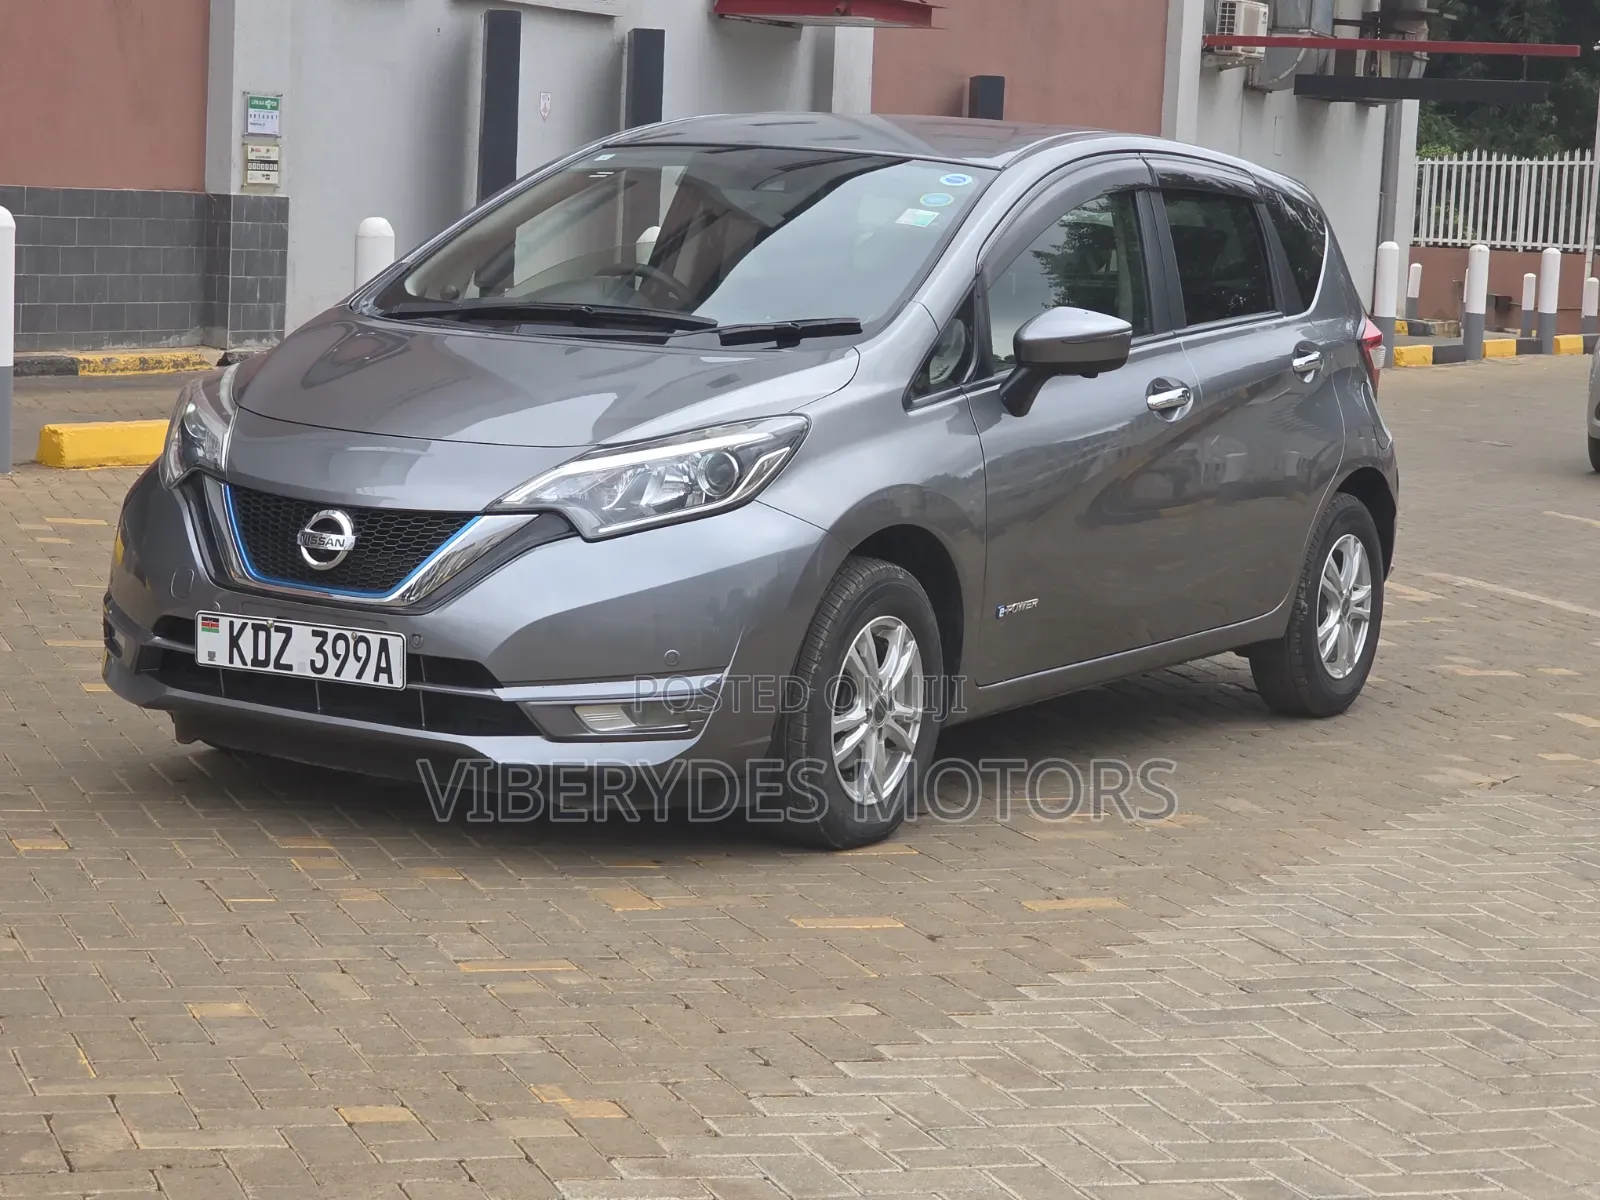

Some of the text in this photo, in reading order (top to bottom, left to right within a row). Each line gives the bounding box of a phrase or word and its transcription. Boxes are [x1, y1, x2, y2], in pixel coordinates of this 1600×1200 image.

[301, 534, 346, 548] NISSAN
[228, 620, 293, 671] KDZ
[309, 629, 394, 684] 399A
